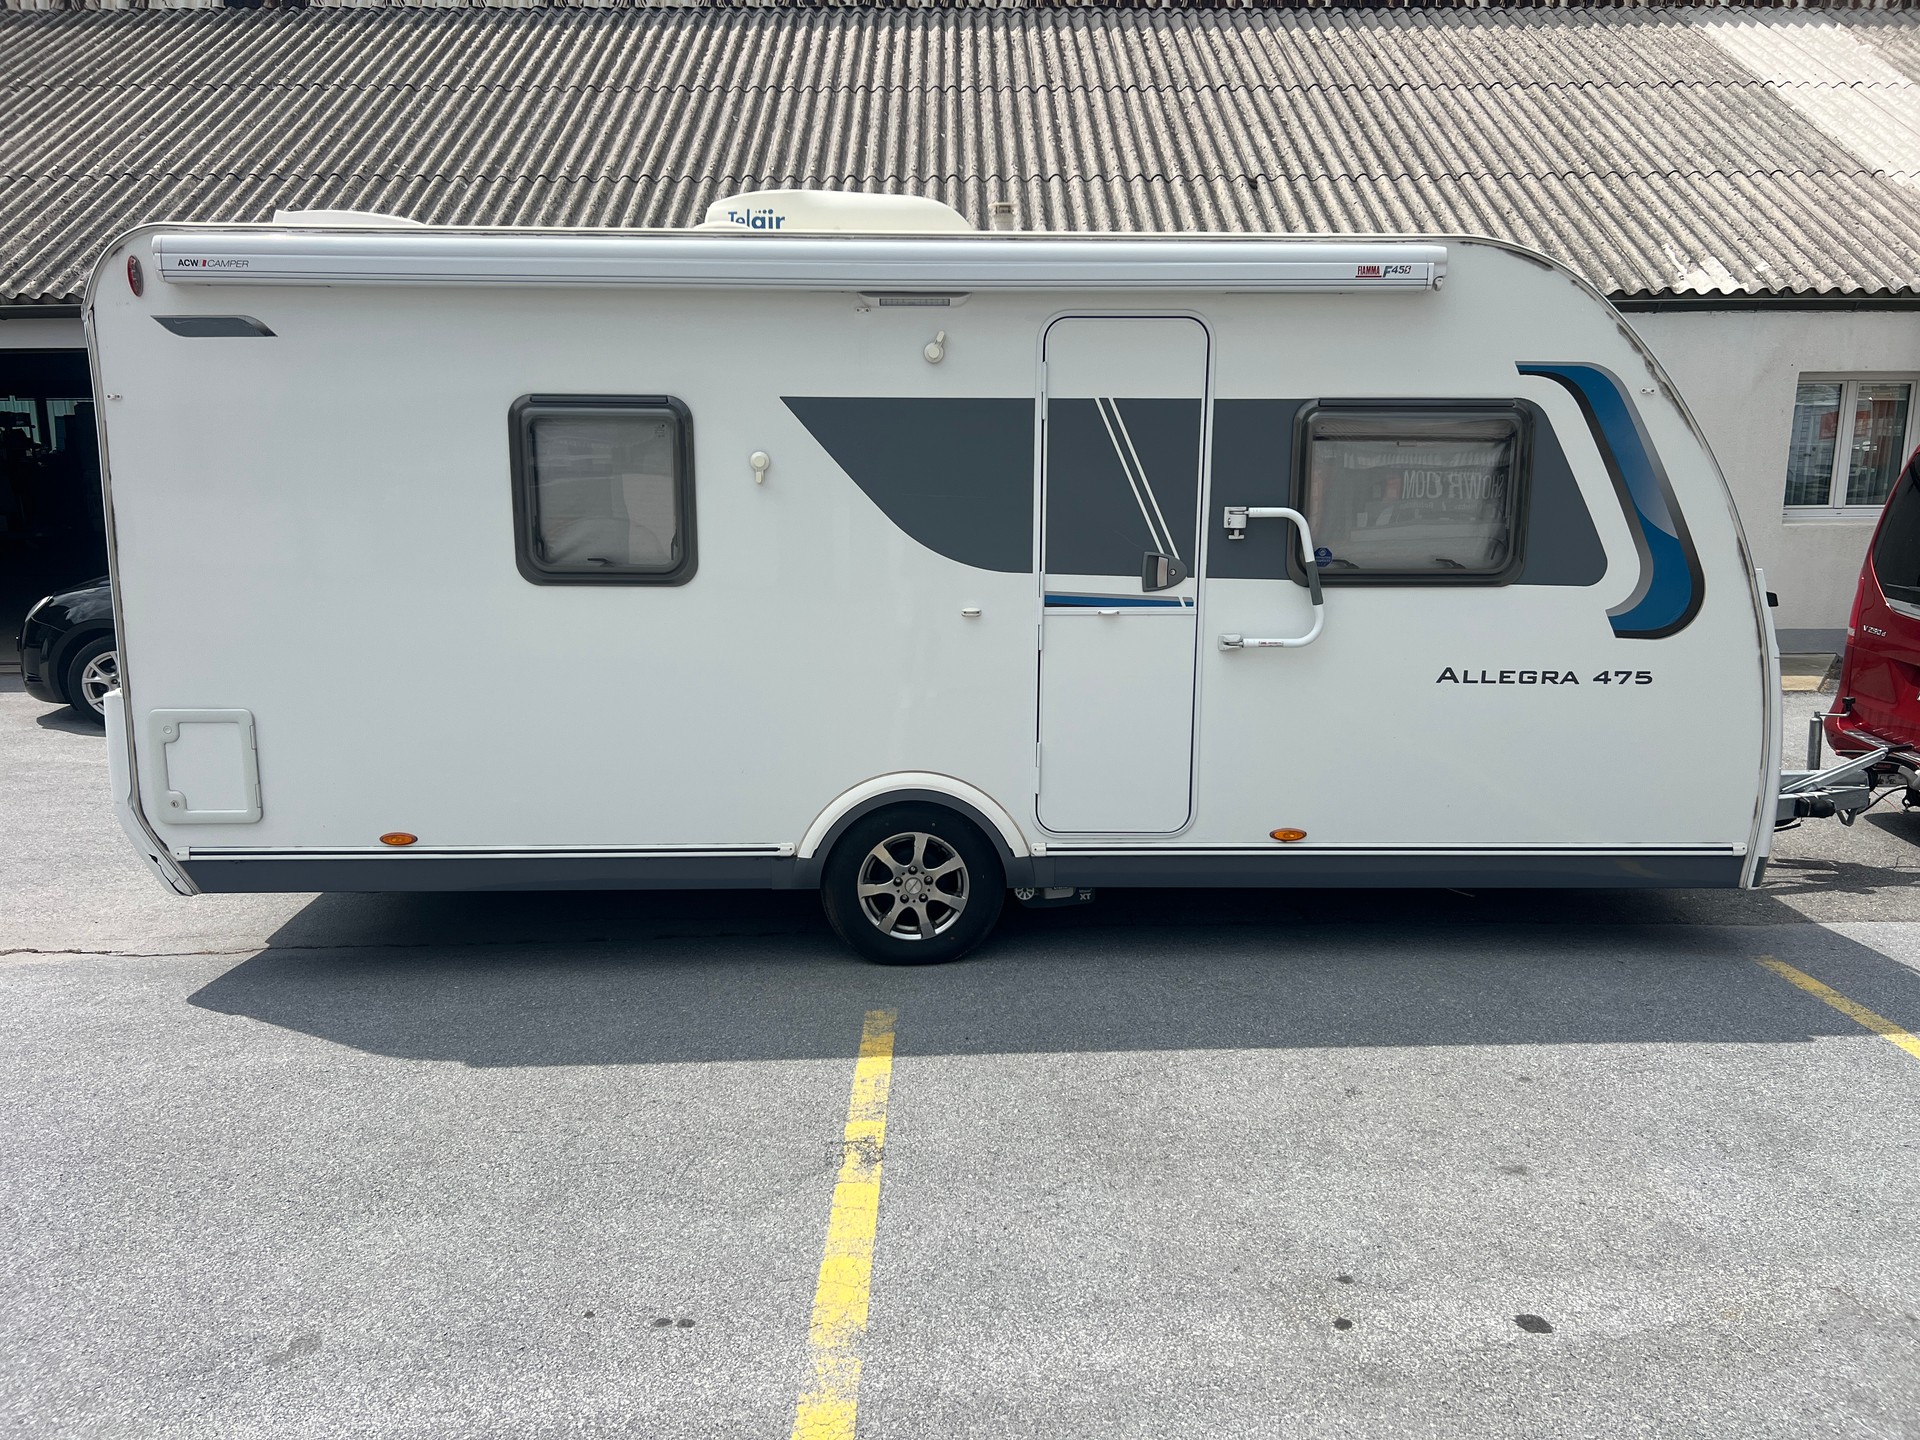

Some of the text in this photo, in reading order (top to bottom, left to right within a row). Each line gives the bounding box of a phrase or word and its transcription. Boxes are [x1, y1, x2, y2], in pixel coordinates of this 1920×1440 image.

[177, 259, 250, 268] ACW CAMPER
[1357, 265, 1381, 276] FIAMMA
[1436, 667, 1654, 685] ALLEGRA 475
